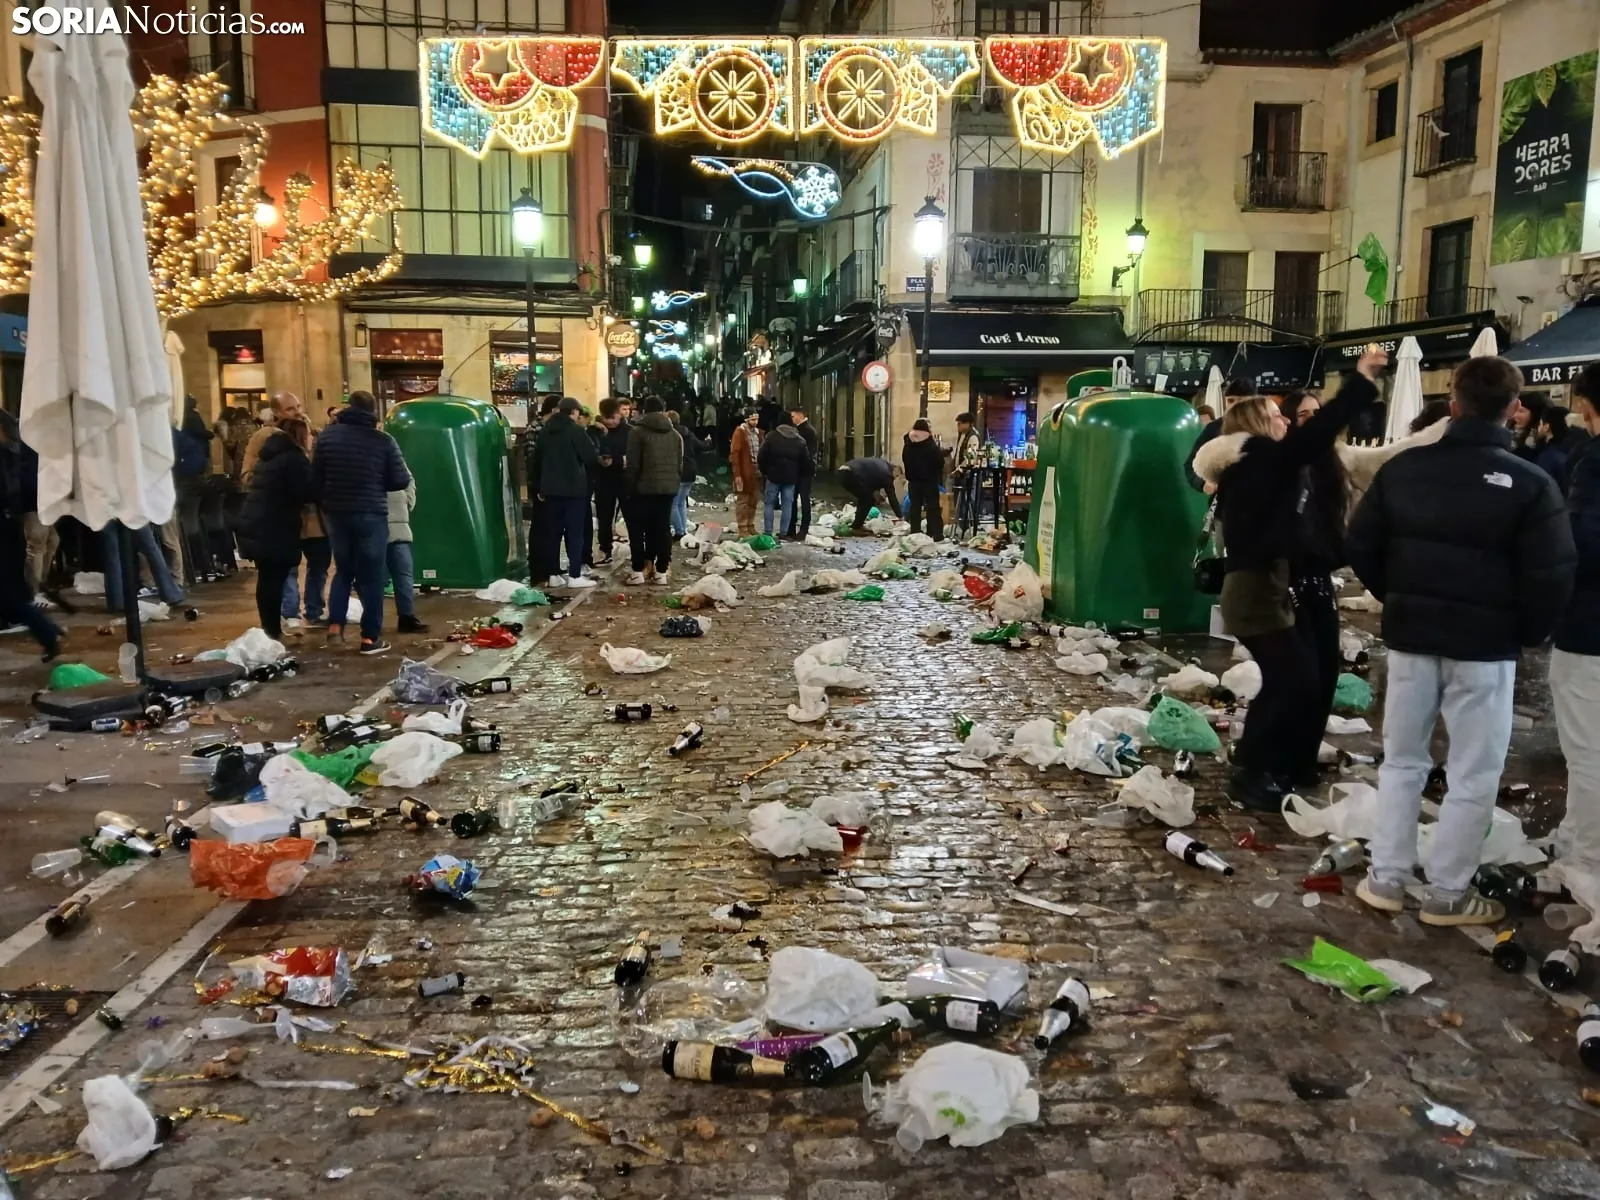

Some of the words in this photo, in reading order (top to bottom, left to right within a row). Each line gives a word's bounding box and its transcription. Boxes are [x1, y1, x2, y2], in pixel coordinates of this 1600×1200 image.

[1516, 133, 1571, 162] HERRA
[1514, 153, 1572, 184] DORES
[1532, 366, 1562, 383] BAR
